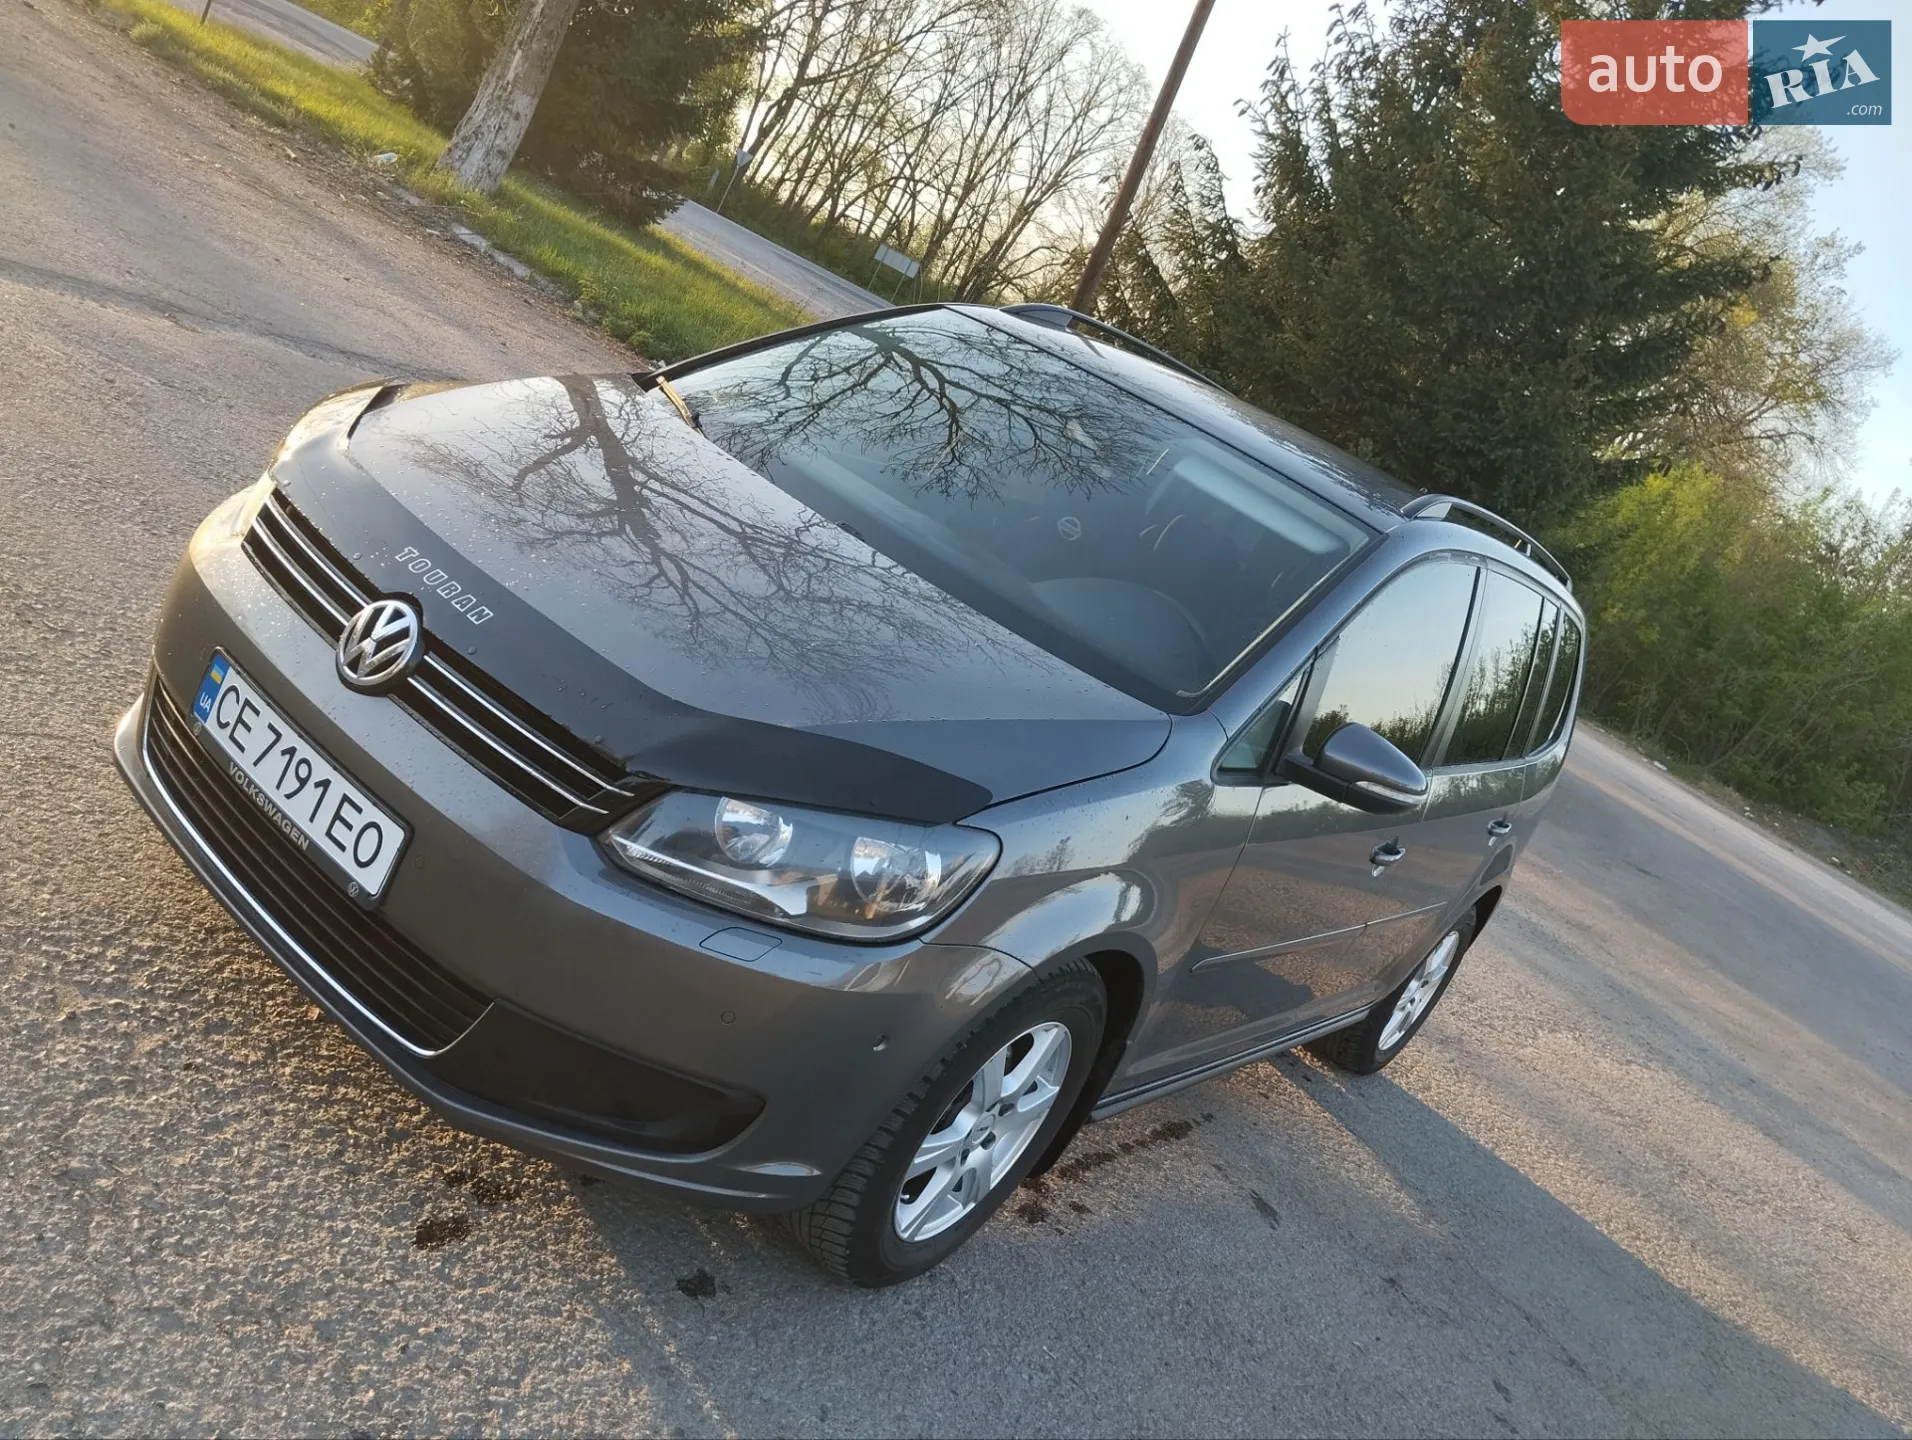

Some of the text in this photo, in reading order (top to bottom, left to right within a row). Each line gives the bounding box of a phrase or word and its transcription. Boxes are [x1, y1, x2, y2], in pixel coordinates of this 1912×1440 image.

[395, 546, 494, 625] TOURAN
[199, 691, 212, 714] UA
[216, 684, 261, 754] CE
[252, 721, 332, 824] 7191
[228, 761, 310, 851] VOLKSWAGEN
